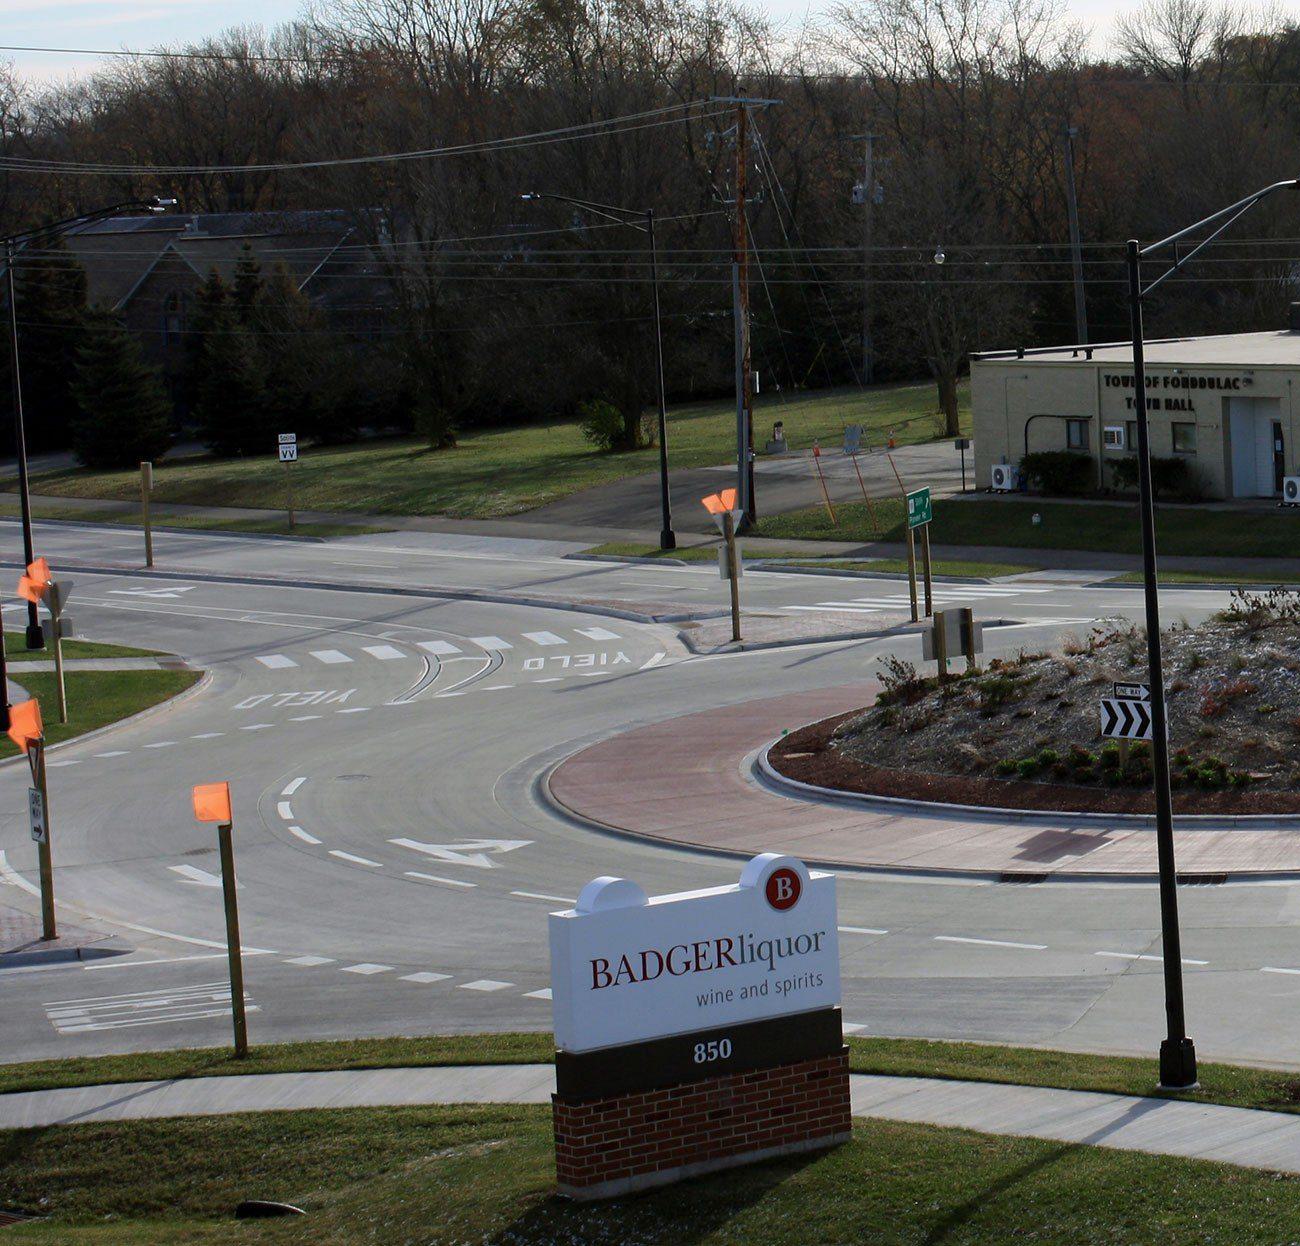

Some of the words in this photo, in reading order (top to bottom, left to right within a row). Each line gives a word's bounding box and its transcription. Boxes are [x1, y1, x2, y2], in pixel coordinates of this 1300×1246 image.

[1105, 376, 1136, 388] TOW
[1144, 376, 1160, 388] OF
[1164, 398, 1195, 411] HALL
[523, 651, 632, 671] YIELD
[233, 688, 358, 711] YIELD
[775, 876, 793, 902] B
[589, 930, 826, 990] BADGERliquor
[696, 988, 734, 1007] wine
[740, 979, 769, 1000] and
[775, 971, 824, 996] spirits
[693, 1038, 732, 1064] 850
